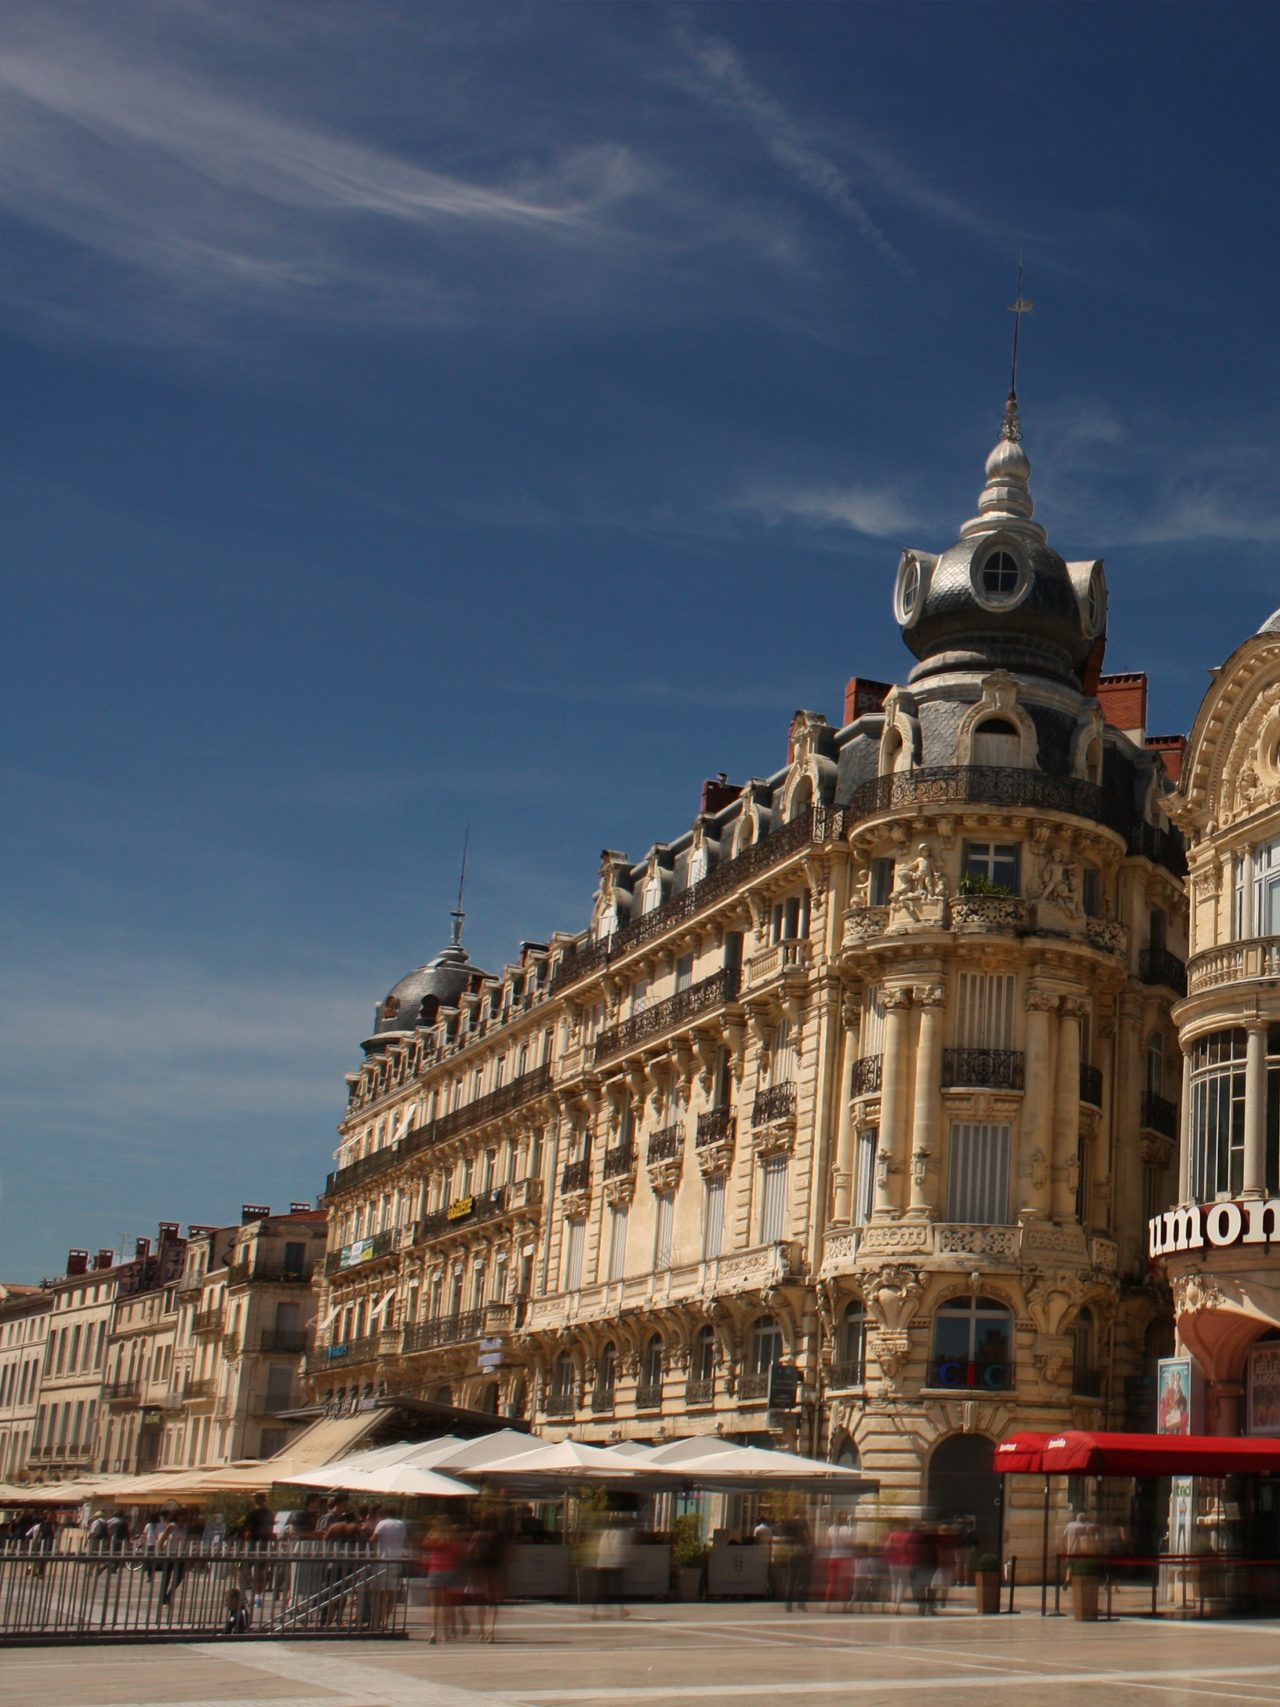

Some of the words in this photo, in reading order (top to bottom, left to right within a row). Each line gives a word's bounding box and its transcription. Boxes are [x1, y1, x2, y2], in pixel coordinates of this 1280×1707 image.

[939, 1360, 1005, 1389] CIC
[1255, 1362, 1280, 1374] BELLE
[1253, 1374, 1280, 1387] SAISON
